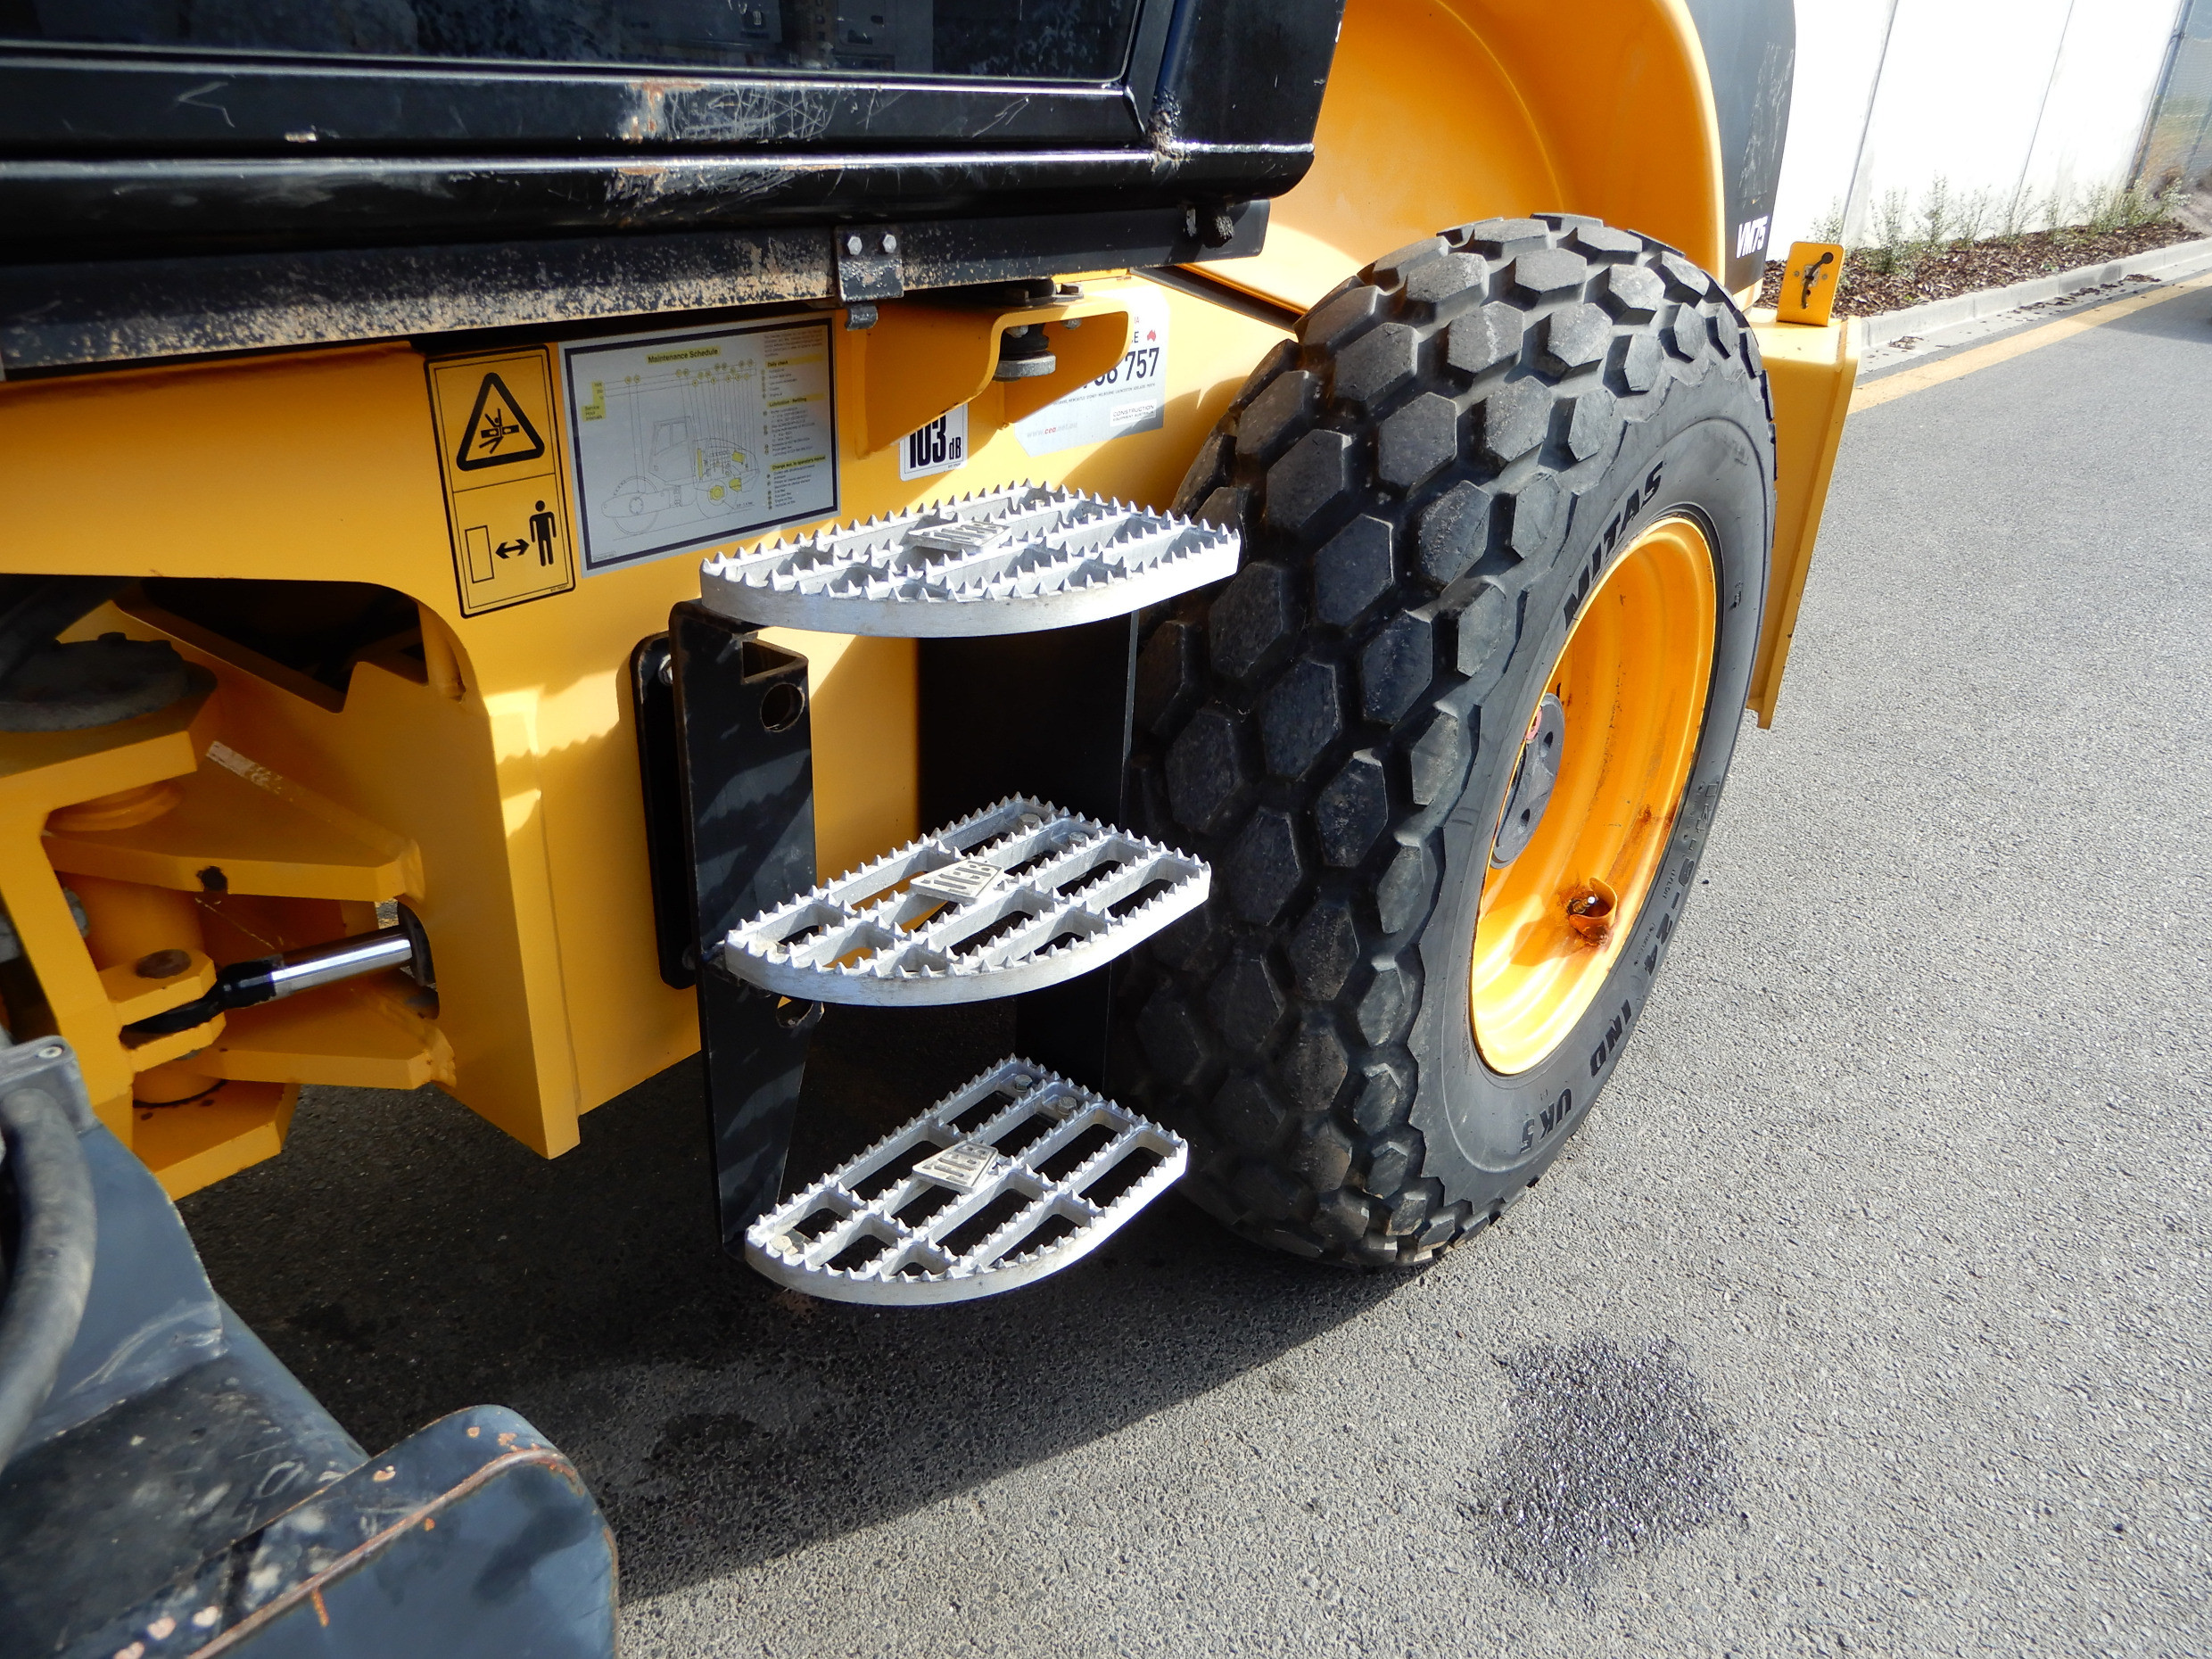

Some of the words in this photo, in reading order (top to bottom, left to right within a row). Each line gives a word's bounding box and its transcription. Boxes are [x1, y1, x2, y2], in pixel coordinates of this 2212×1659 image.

[1736, 215, 1769, 259] VM75
[648, 353, 689, 363] Maintenance
[689, 348, 719, 358] Schedule
[1125, 347, 1160, 381] 757
[1112, 405, 1154, 417] CONSTRUCTION
[949, 436, 962, 460] dB
[1564, 460, 1665, 631] MITAS
[1590, 998, 1631, 1078] IND
